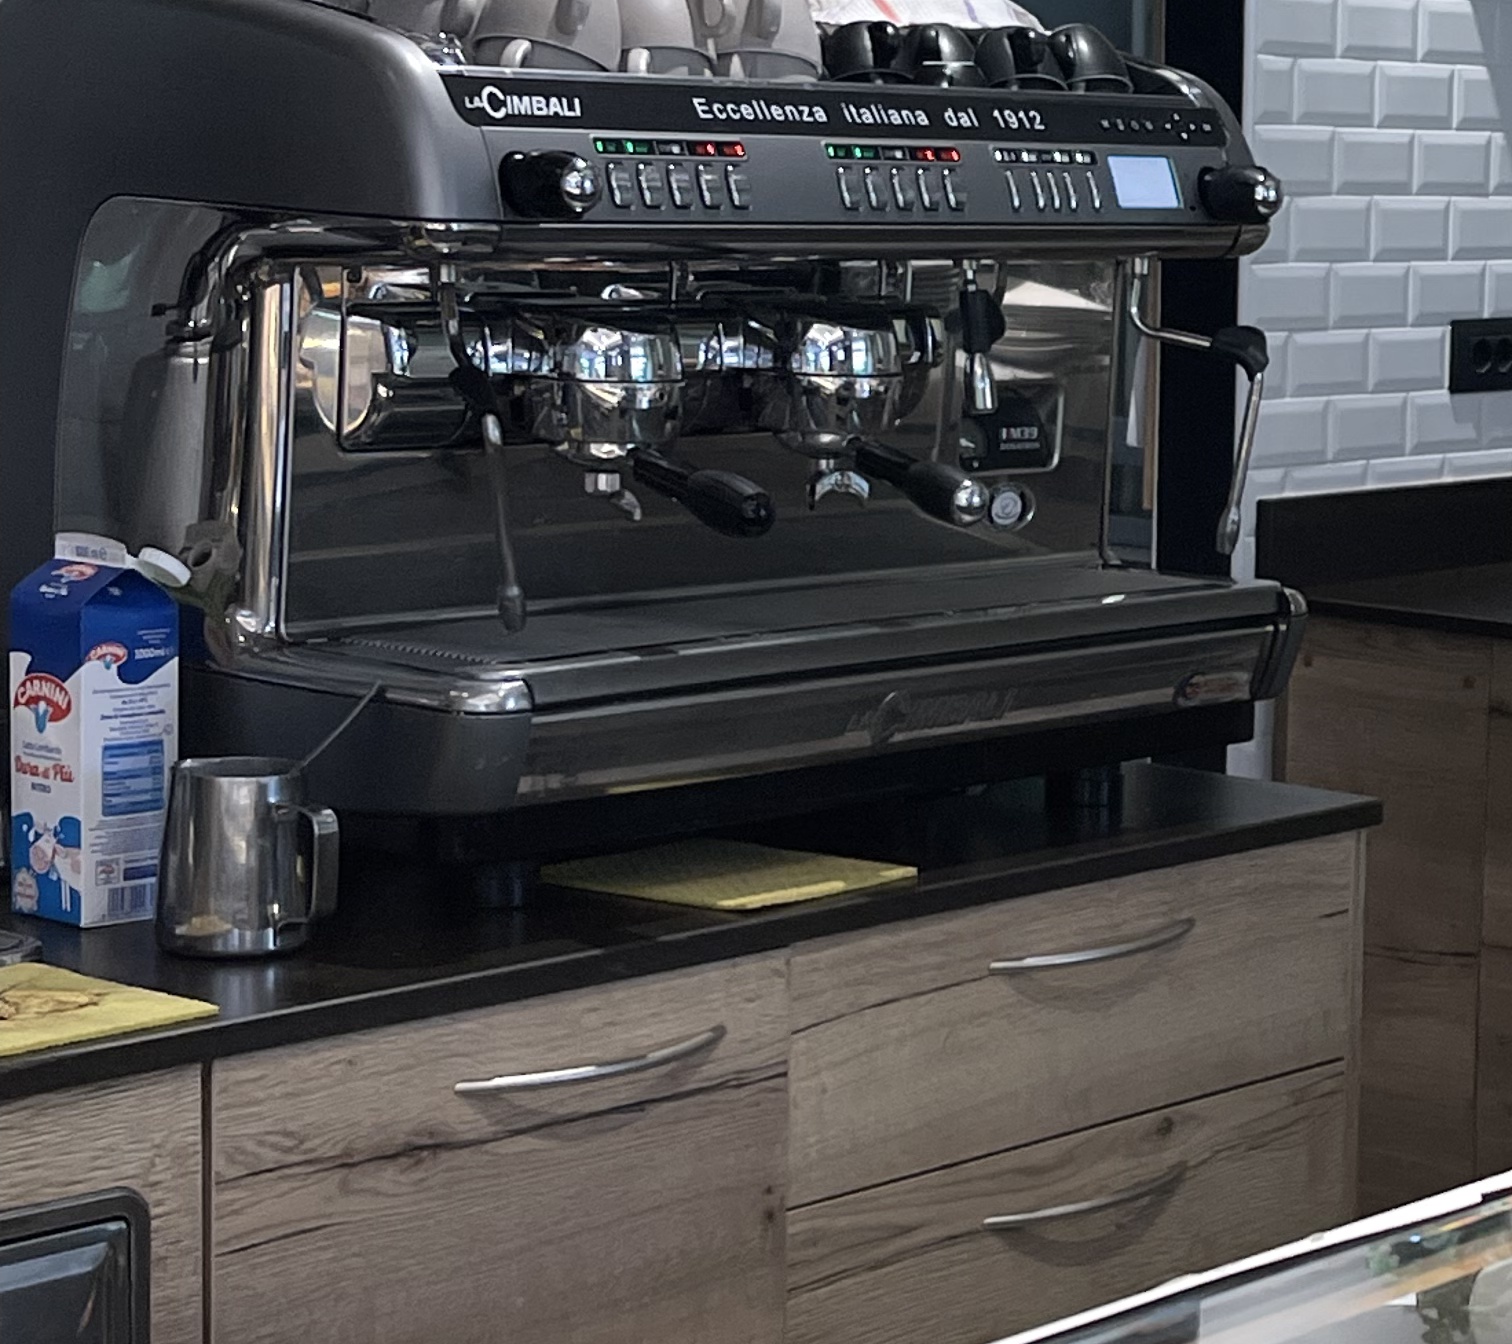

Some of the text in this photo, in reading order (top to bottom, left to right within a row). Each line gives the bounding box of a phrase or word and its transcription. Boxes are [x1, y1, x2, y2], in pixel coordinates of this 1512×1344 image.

[464, 85, 582, 120] LA CIMBALI
[691, 97, 1046, 131] Eccellenza italiana dal 1912
[16, 679, 70, 710] CARNINI
